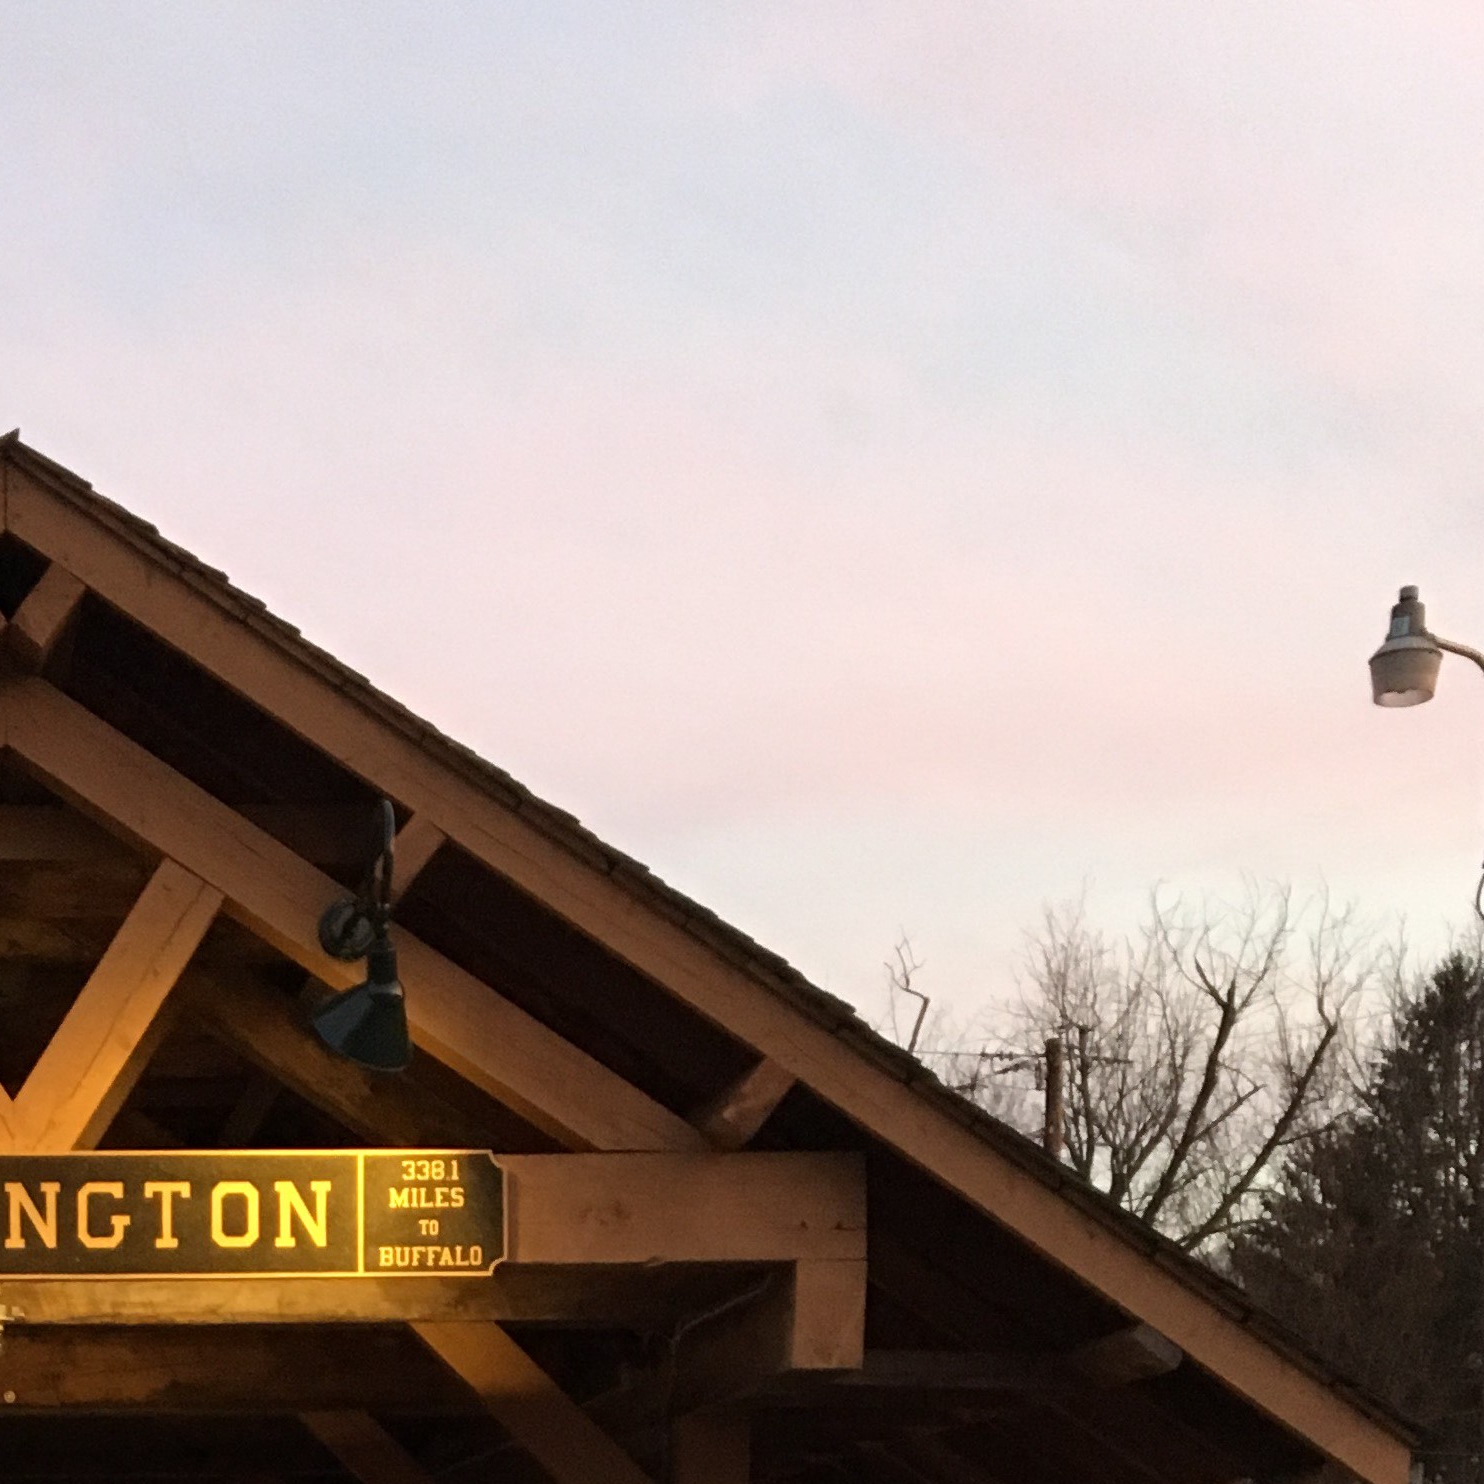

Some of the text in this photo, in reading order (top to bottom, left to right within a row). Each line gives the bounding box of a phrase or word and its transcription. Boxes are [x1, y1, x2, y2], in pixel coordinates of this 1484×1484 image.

[401, 1159, 459, 1181] 338.1
[388, 1187, 465, 1208] MILES
[418, 1219, 439, 1236] TO
[379, 1245, 482, 1267] BUFFALO
